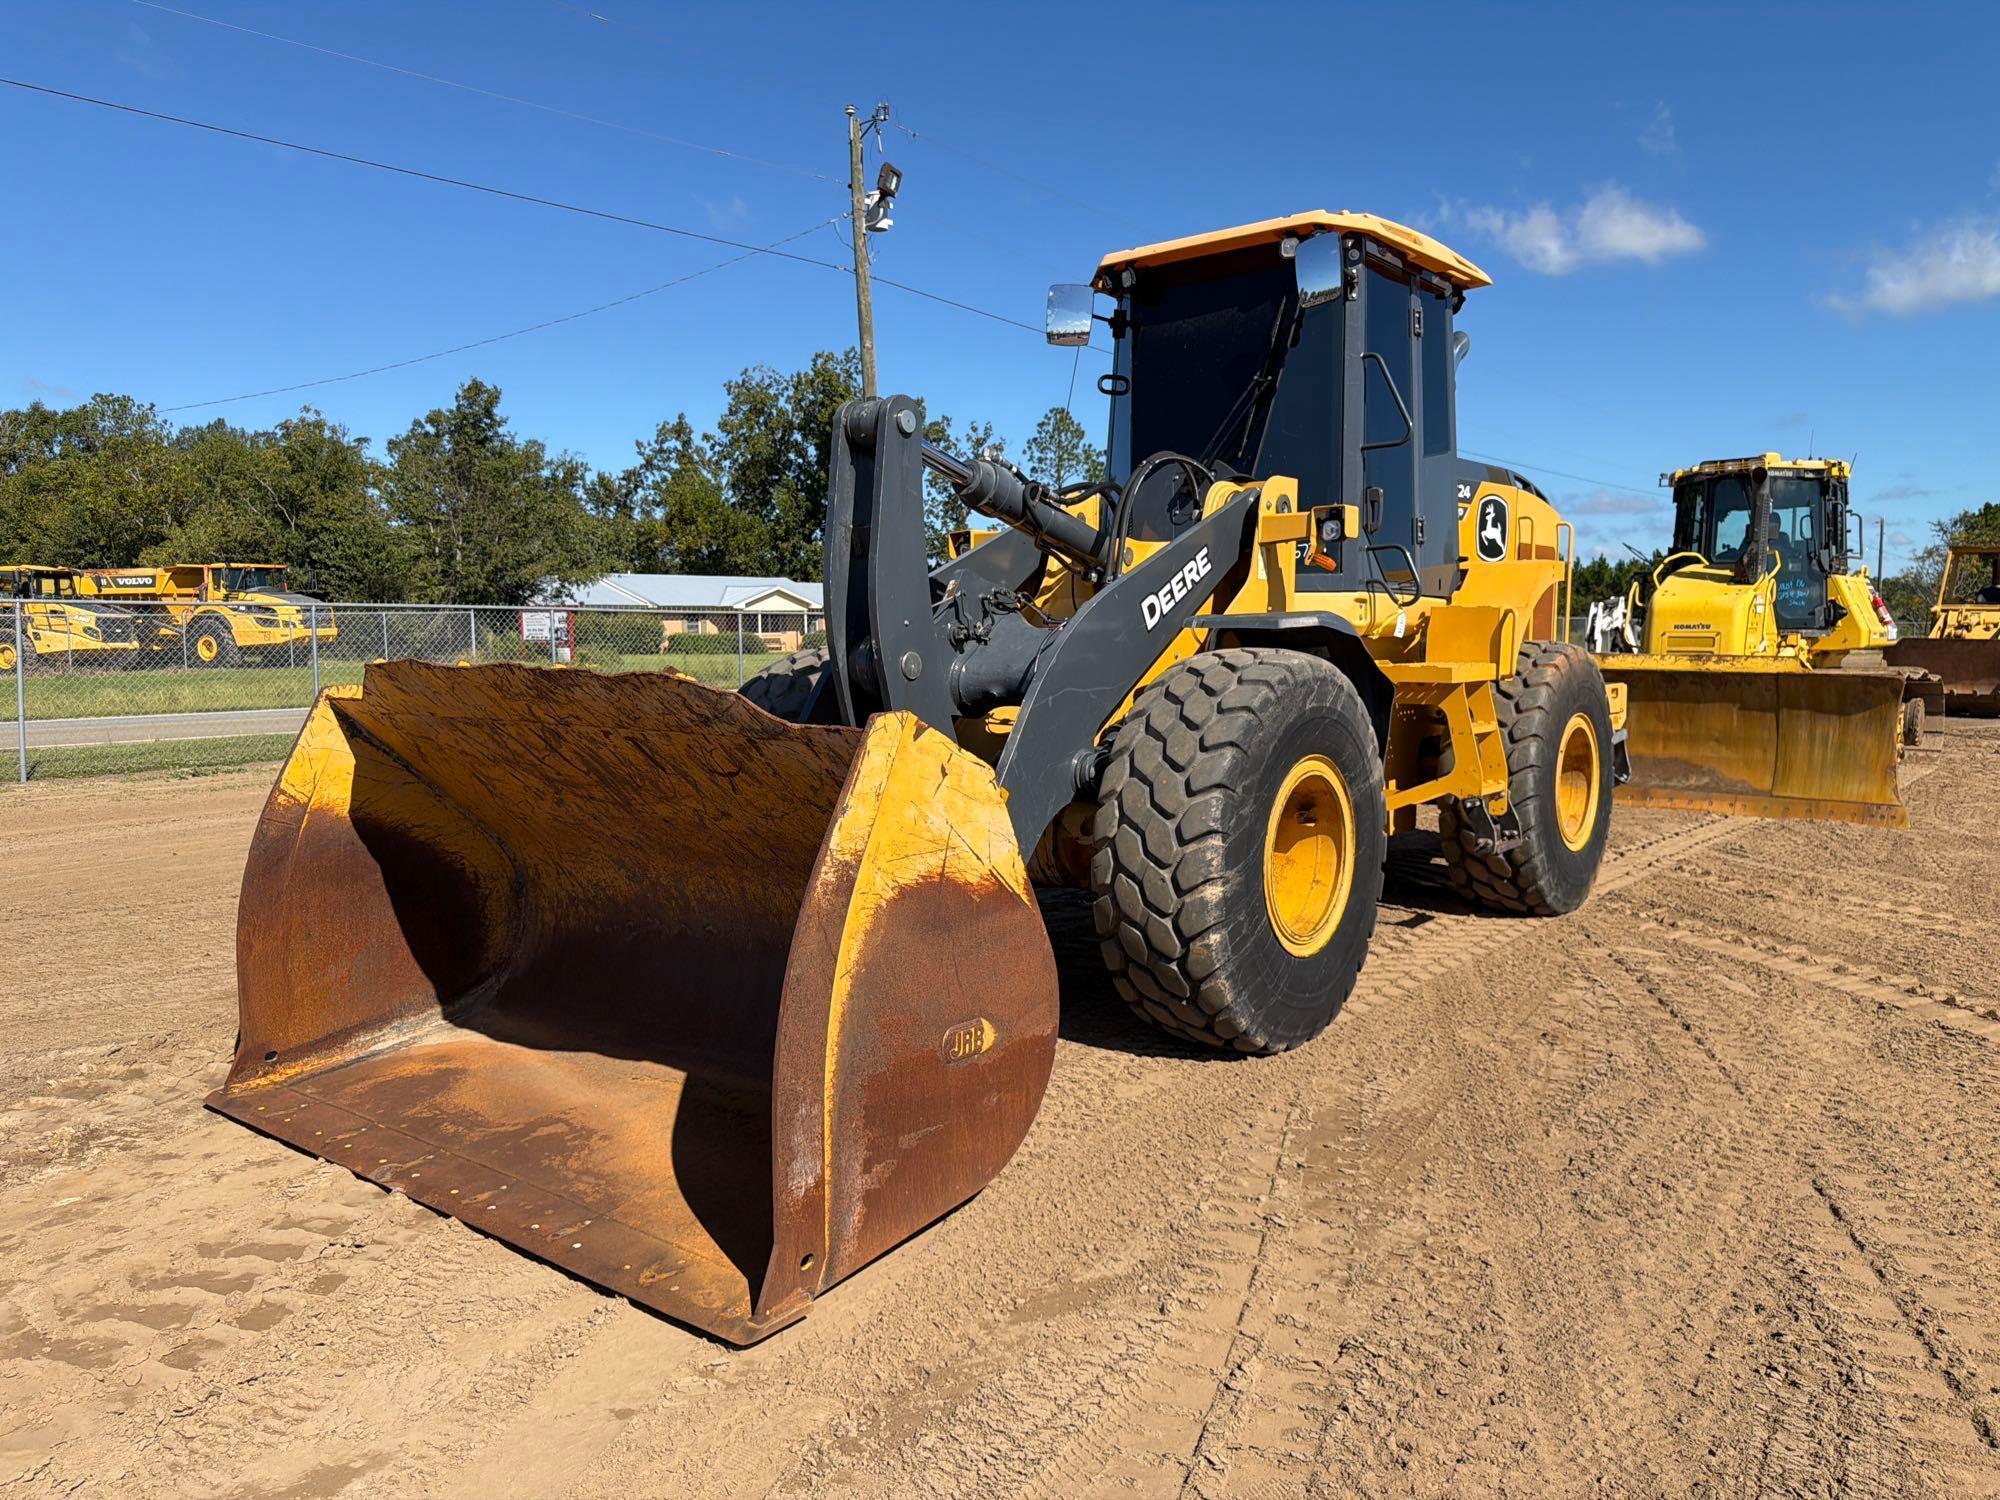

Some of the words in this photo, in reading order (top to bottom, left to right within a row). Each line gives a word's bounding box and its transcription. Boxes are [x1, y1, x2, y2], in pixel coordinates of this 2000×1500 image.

[116, 577, 153, 585] VOLVO
[1140, 546, 1212, 631] DEERE
[1674, 622, 1711, 630] KOMATSU
